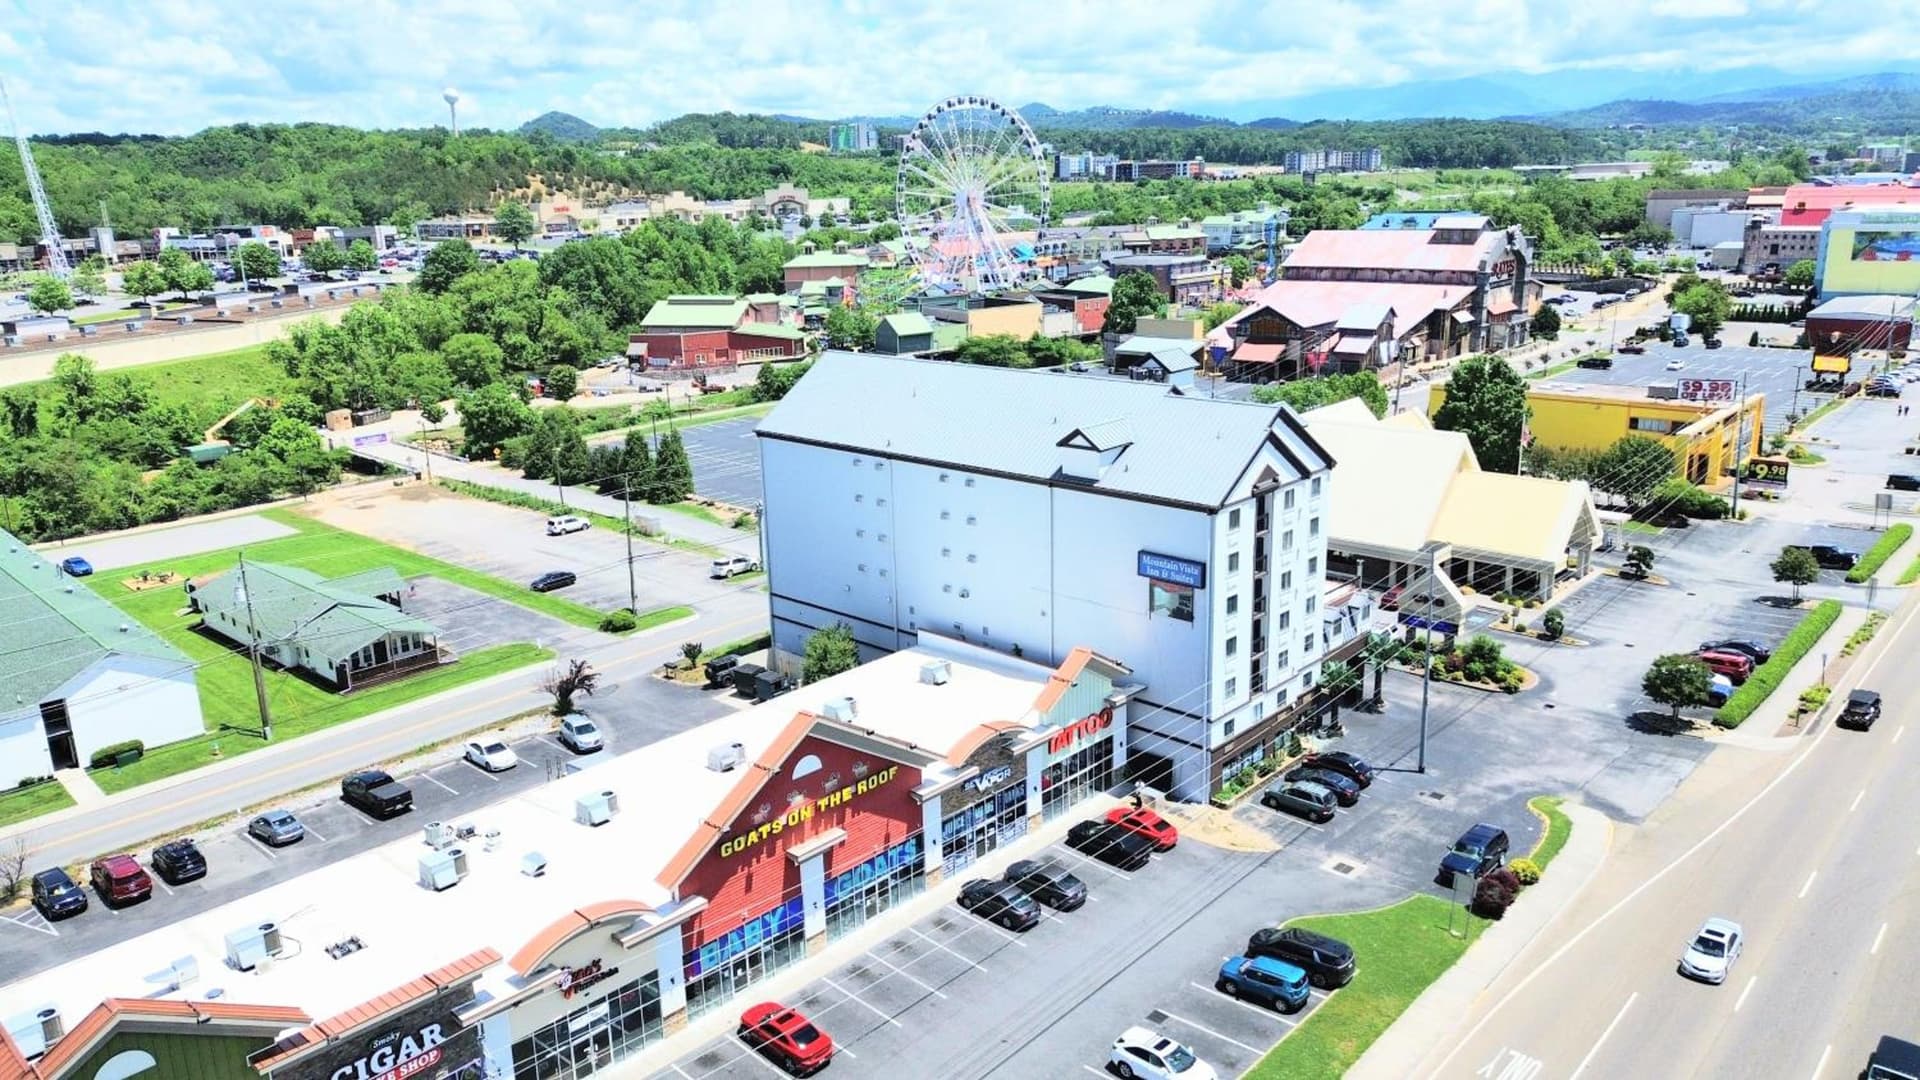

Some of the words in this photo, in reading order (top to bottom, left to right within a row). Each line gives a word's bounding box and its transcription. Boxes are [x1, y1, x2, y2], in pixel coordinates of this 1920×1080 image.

[1751, 463, 1786, 480] $9.98
[1142, 554, 1179, 571] Mountain
[1179, 562, 1199, 576] Vista
[1047, 706, 1113, 755] TATTOO
[975, 767, 1011, 794] VAPOR
[720, 821, 784, 858] GOATS
[787, 803, 817, 828] ON
[817, 786, 853, 814] THE
[857, 766, 899, 796] ROOF
[701, 905, 787, 972] BABY
[372, 1031, 402, 1049] Smoky
[399, 1049, 439, 1077] SHOP
